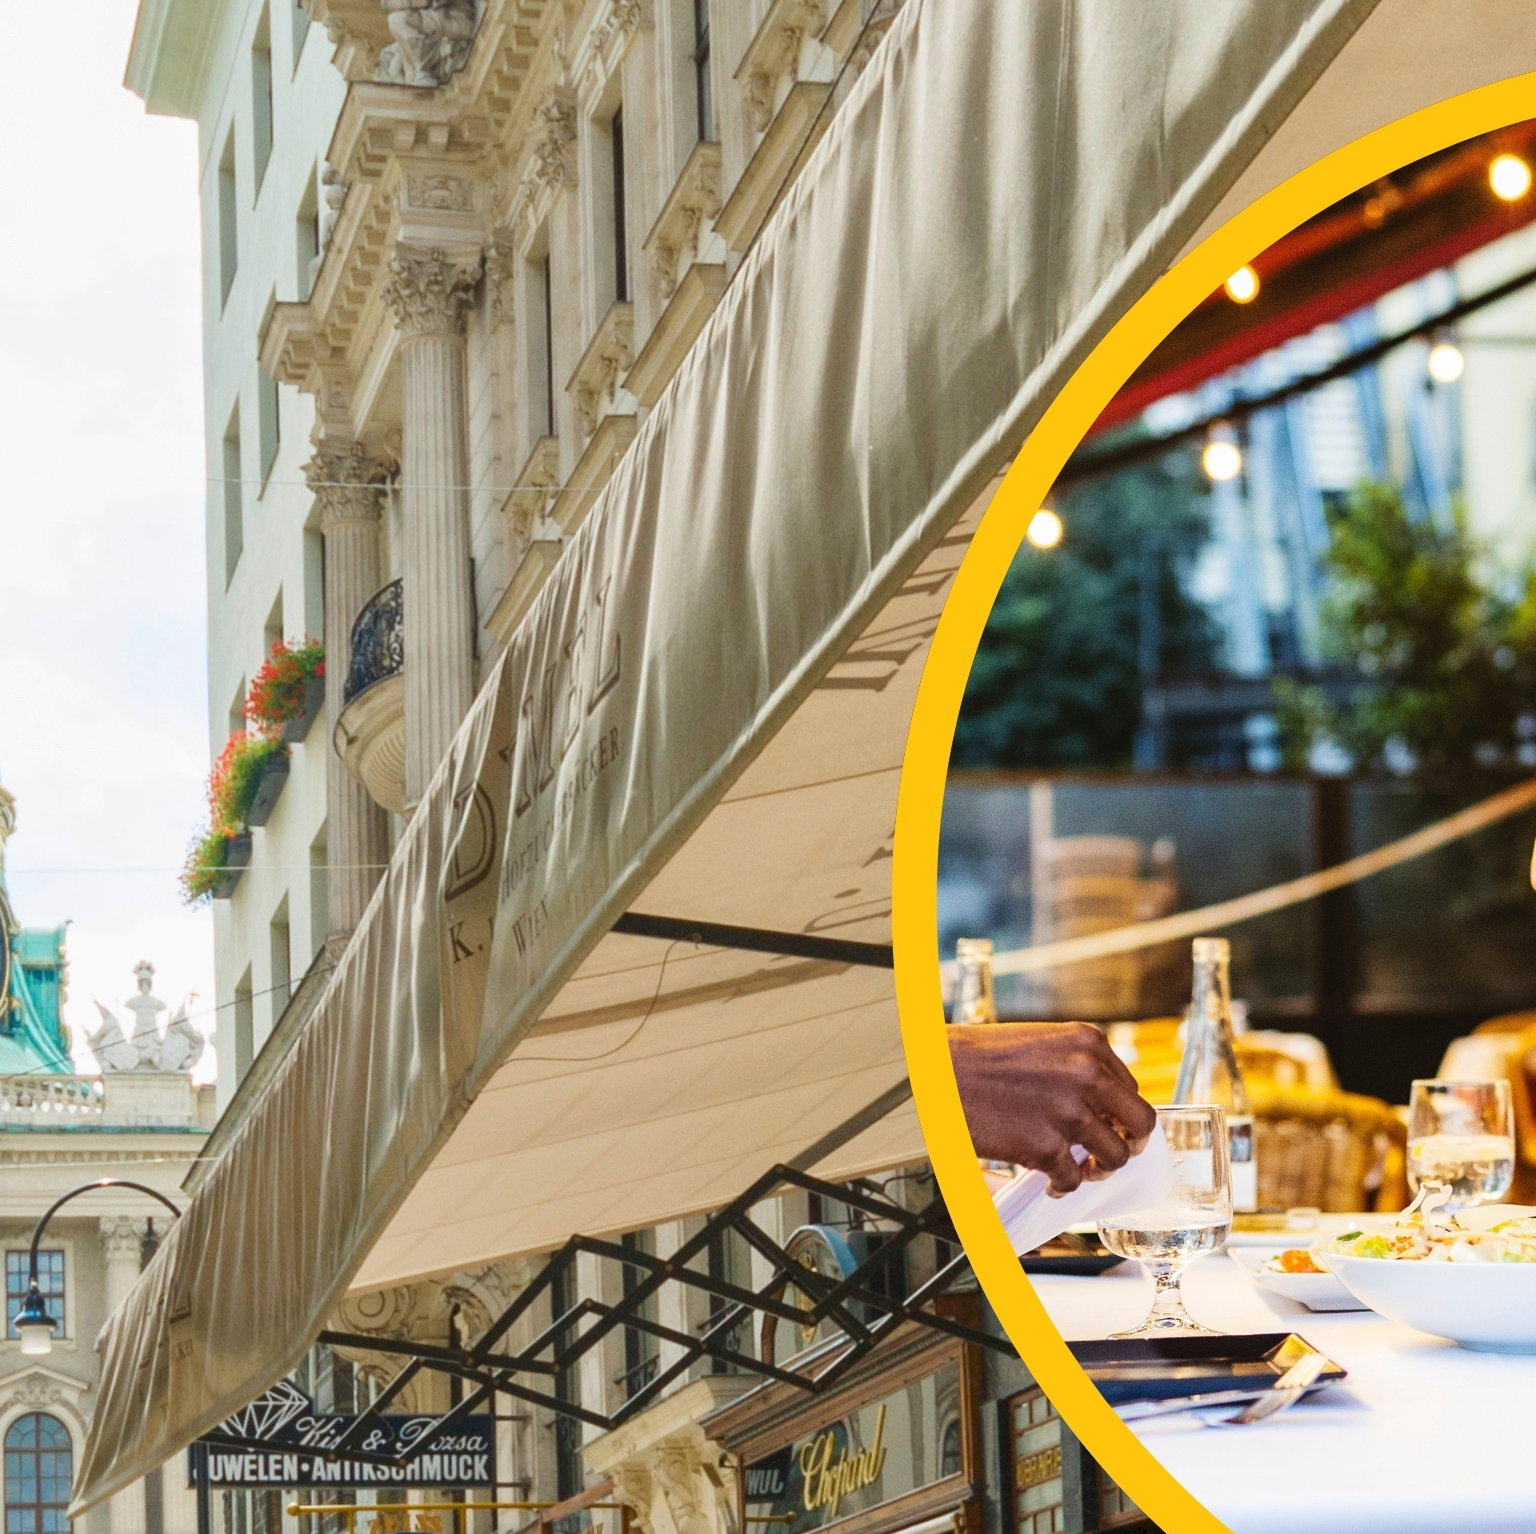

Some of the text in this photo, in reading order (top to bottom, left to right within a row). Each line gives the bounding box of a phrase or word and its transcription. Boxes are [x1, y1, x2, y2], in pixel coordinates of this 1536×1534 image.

[445, 574, 621, 903] DMEL
[193, 1454, 298, 1482] UWELEN
[361, 1429, 386, 1451] &
[799, 1404, 887, 1518] Chopard
